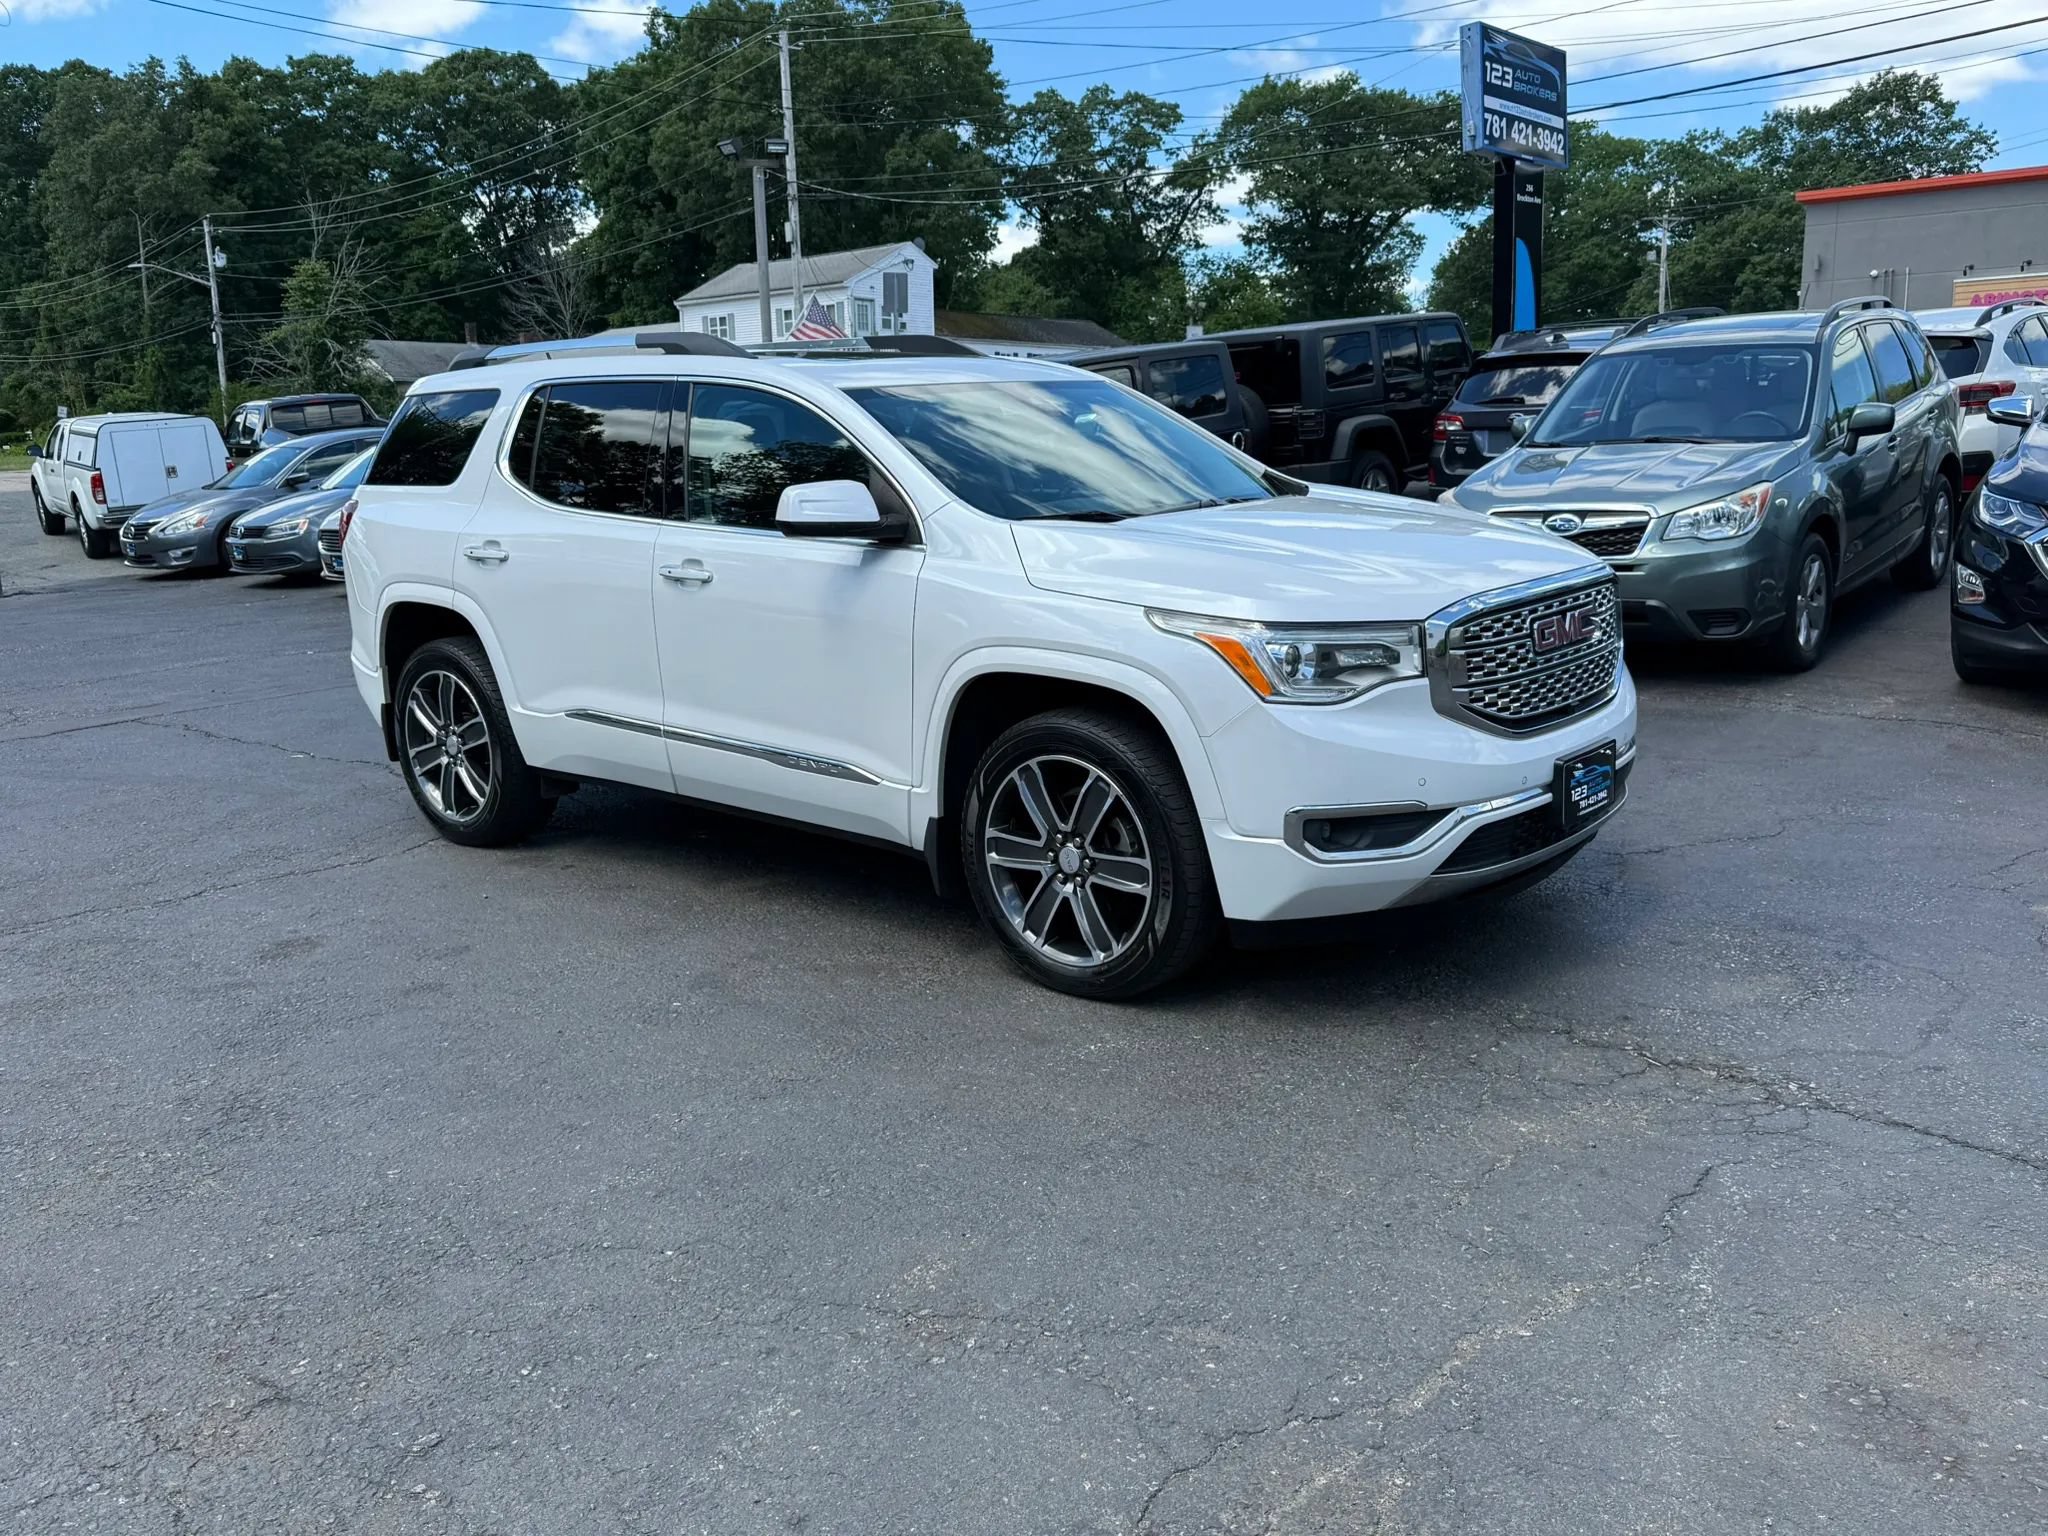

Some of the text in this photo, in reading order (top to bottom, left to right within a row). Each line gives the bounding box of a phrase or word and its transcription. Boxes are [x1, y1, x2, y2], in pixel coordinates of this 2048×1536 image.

[1484, 61, 1513, 88] 123
[1514, 69, 1541, 83] AUTO
[1513, 81, 1557, 102] BROKERS
[1484, 112, 1507, 140] 781
[1511, 121, 1565, 155] 421-3942
[1535, 606, 1596, 651] GMC
[1571, 785, 1588, 802] 123
